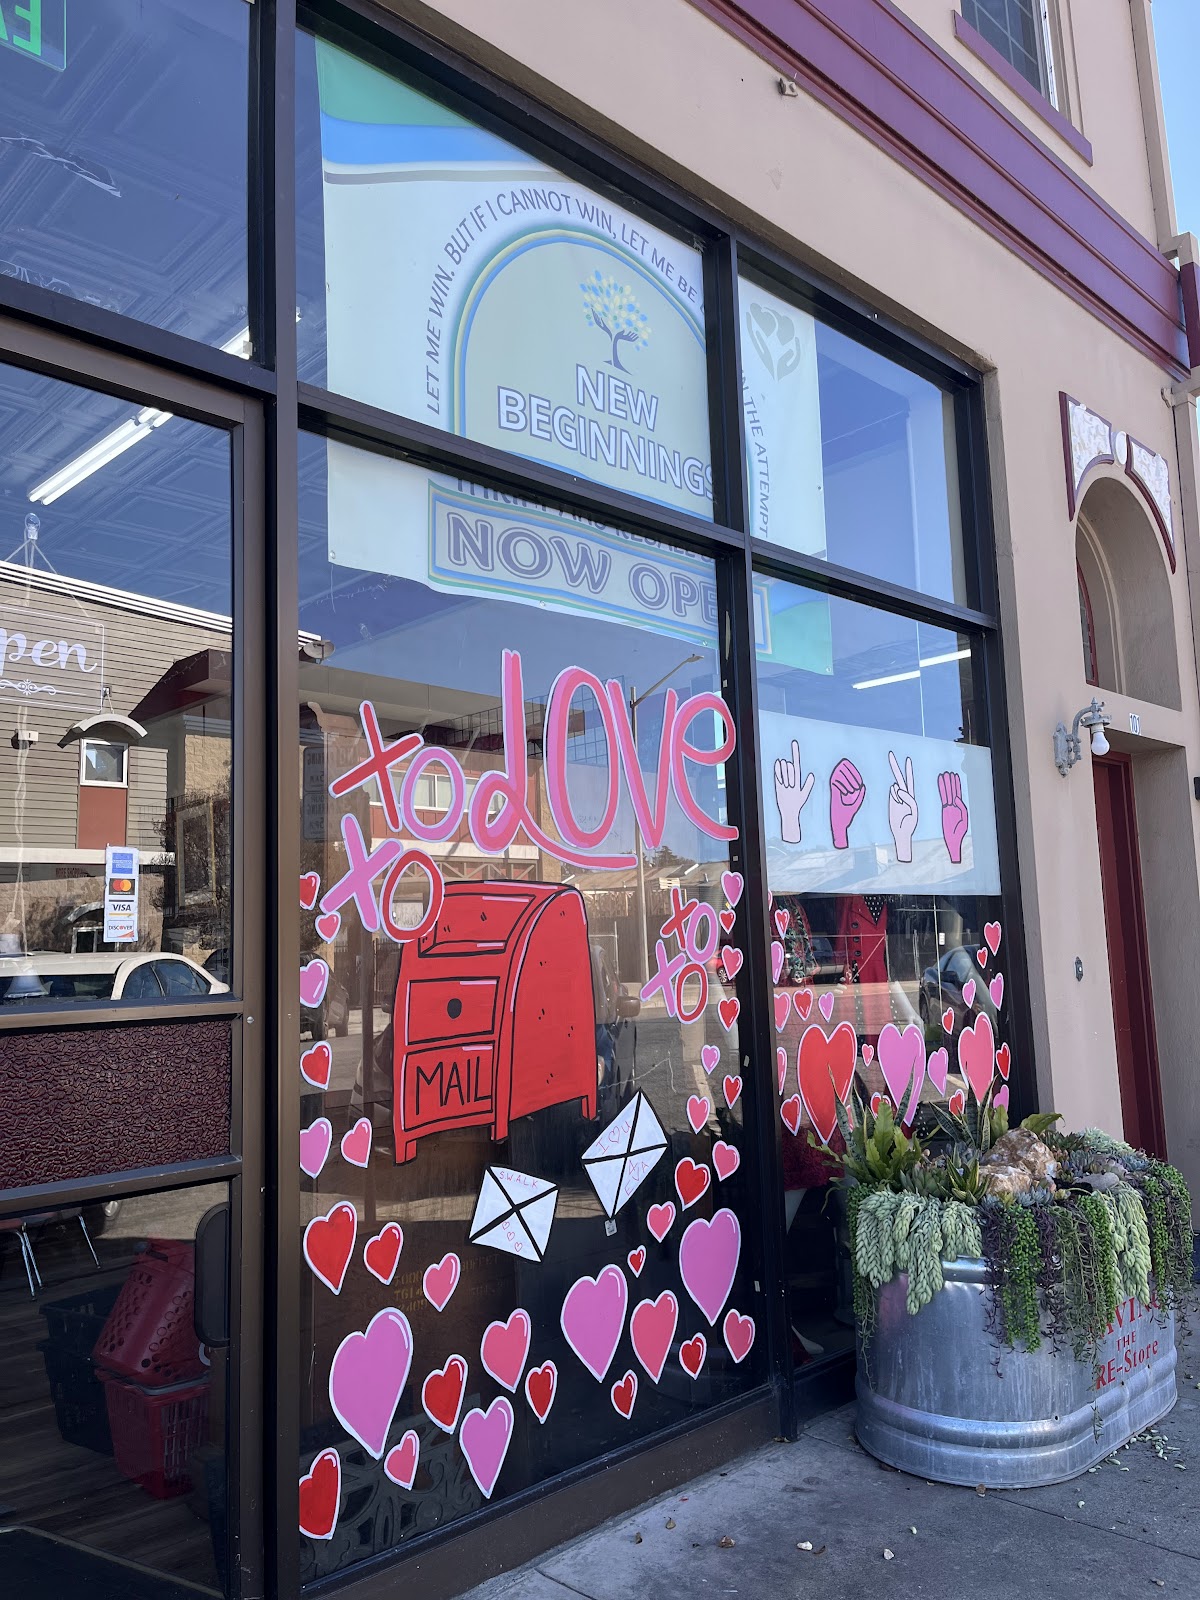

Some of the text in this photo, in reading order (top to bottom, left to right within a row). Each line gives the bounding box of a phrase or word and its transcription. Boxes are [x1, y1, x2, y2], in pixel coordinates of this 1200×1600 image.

[469, 204, 487, 233] IF
[485, 200, 498, 221] I
[496, 188, 571, 216] CANNOT
[575, 198, 617, 240] WIN,
[443, 217, 475, 265] BUT
[621, 222, 649, 256] LET
[651, 247, 675, 281] ME
[677, 275, 698, 303] BE
[425, 319, 441, 364] ME
[425, 365, 440, 415] LET
[575, 363, 659, 432] NEW
[744, 396, 764, 437] THE
[754, 441, 771, 538] ATTEMPT
[447, 511, 612, 595] NOW
[112, 903, 132, 912] VISA
[416, 1056, 492, 1116] MAIL
[1116, 1330, 1137, 1352] THE
[1095, 1340, 1159, 1390] RE-Store
